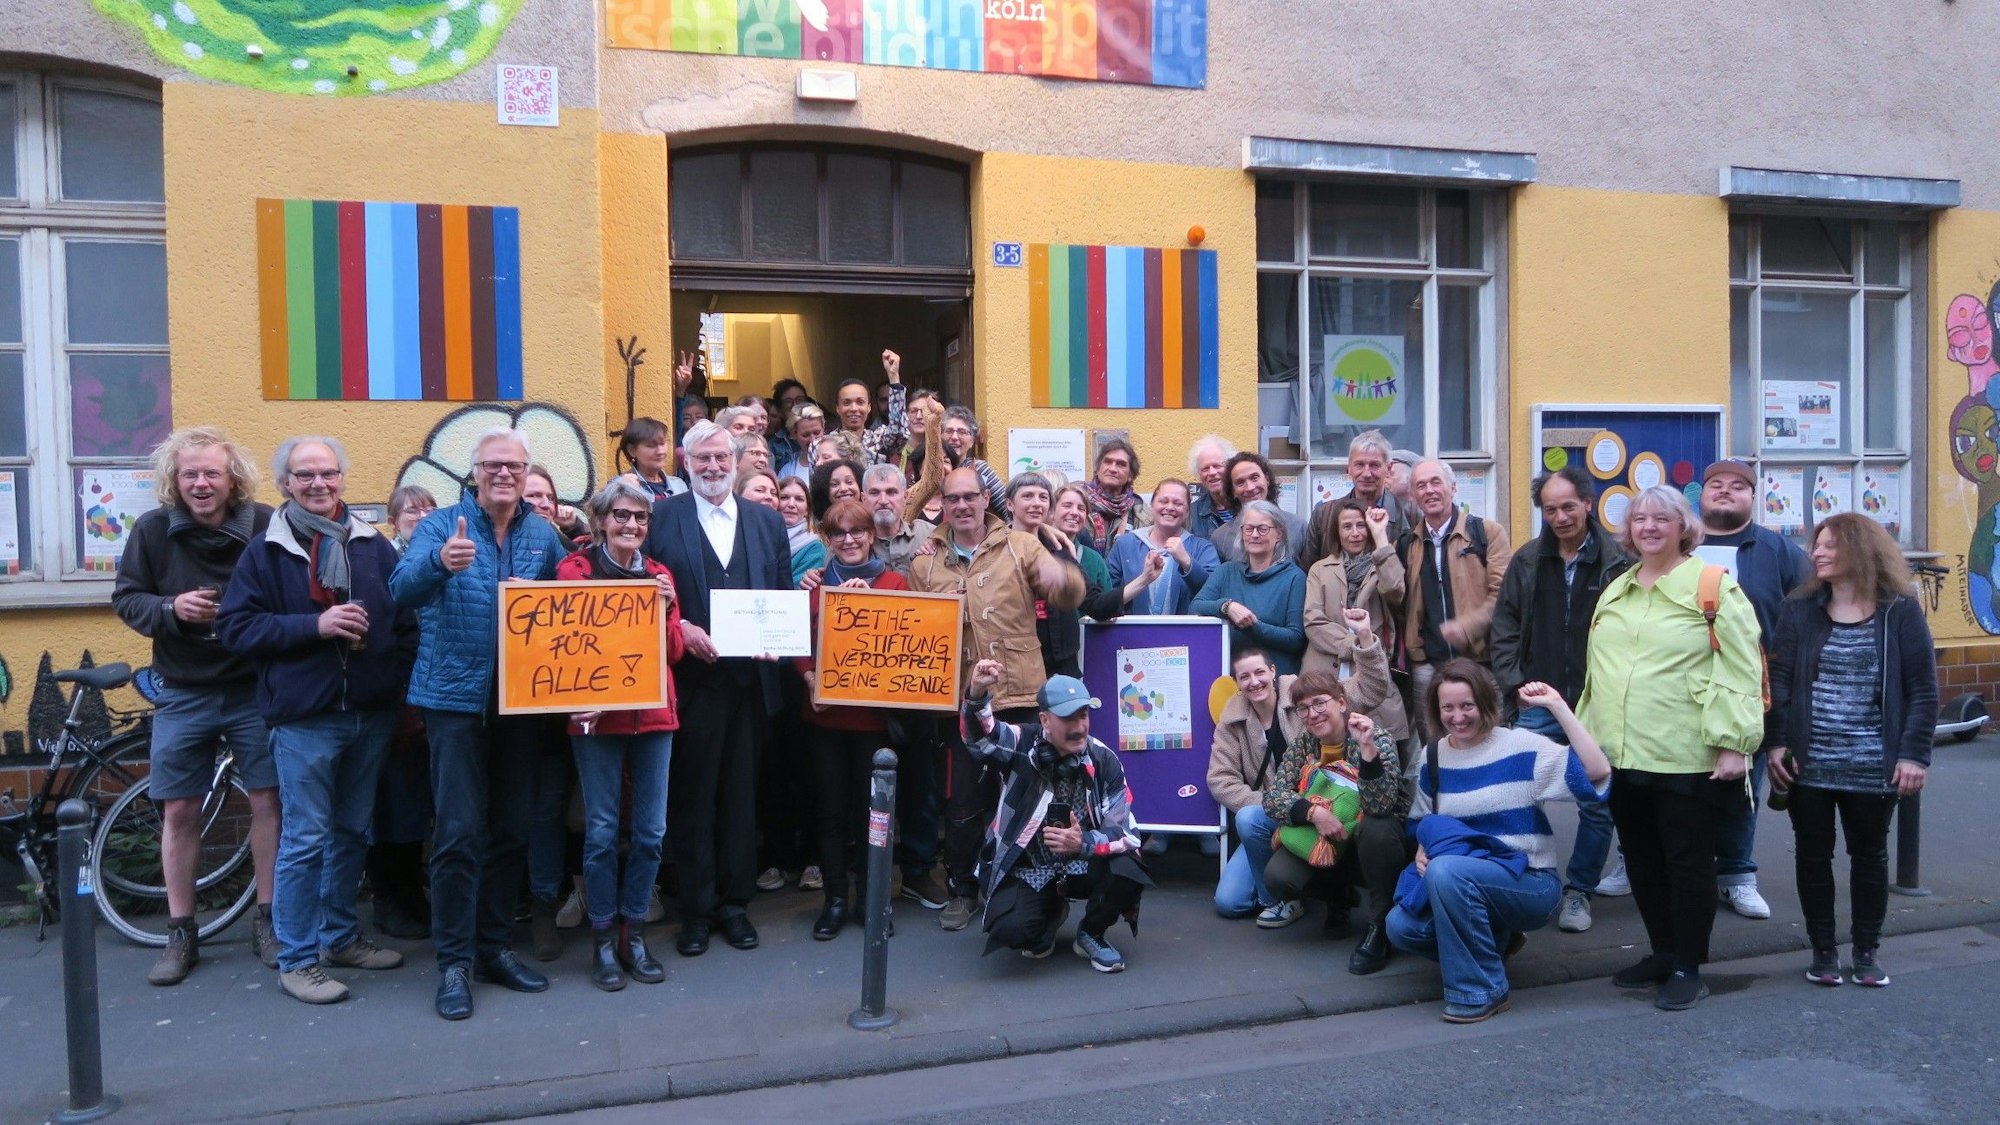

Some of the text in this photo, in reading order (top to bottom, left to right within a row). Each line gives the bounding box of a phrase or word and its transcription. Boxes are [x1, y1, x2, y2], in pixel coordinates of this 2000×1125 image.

[985, 0, 1047, 21] köln
[996, 245, 1019, 263] 3-5
[826, 593, 849, 606] DIE
[506, 590, 657, 646] GEMEINSAM
[832, 606, 921, 631] BETHE-
[549, 630, 602, 660] FÜR
[851, 633, 949, 655] STIFTUNG
[833, 651, 952, 673] VERDOPPELT
[823, 669, 952, 695] DEINE SPENDE
